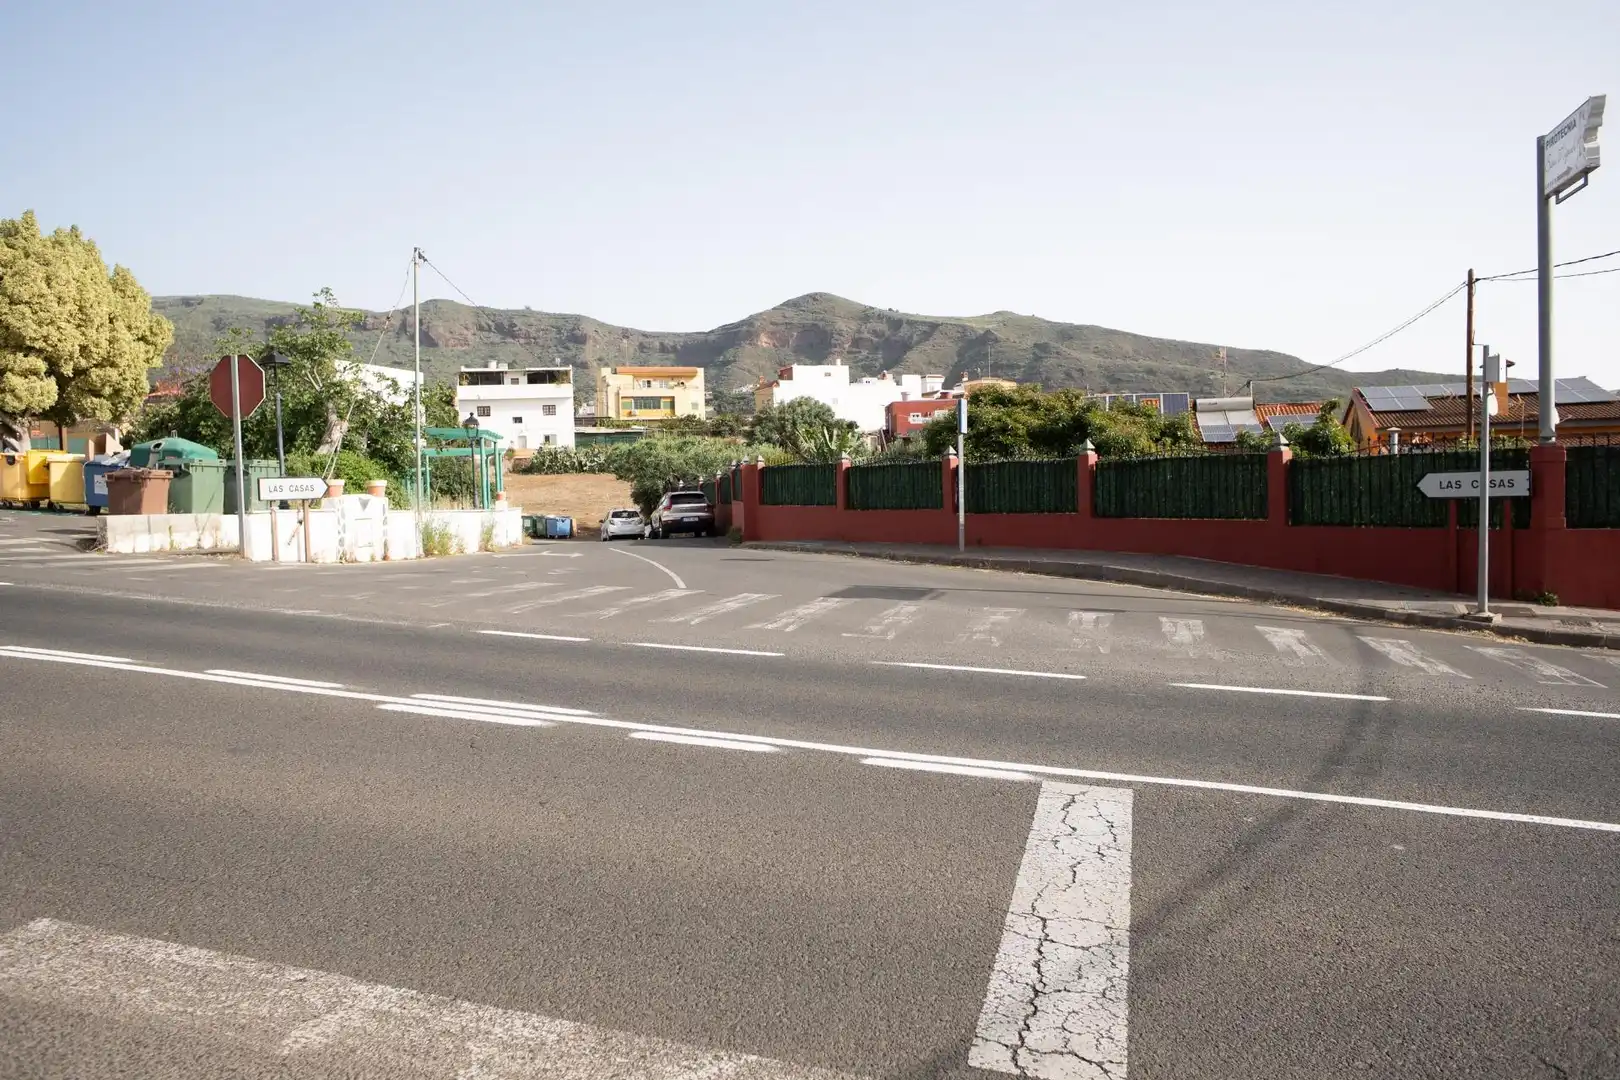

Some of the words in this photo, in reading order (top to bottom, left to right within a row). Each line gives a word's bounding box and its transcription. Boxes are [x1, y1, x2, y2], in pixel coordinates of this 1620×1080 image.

[268, 485, 284, 493] LAS
[288, 484, 315, 493] CASAS
[1439, 480, 1462, 490] LAS
[1471, 478, 1515, 489] CSAS
